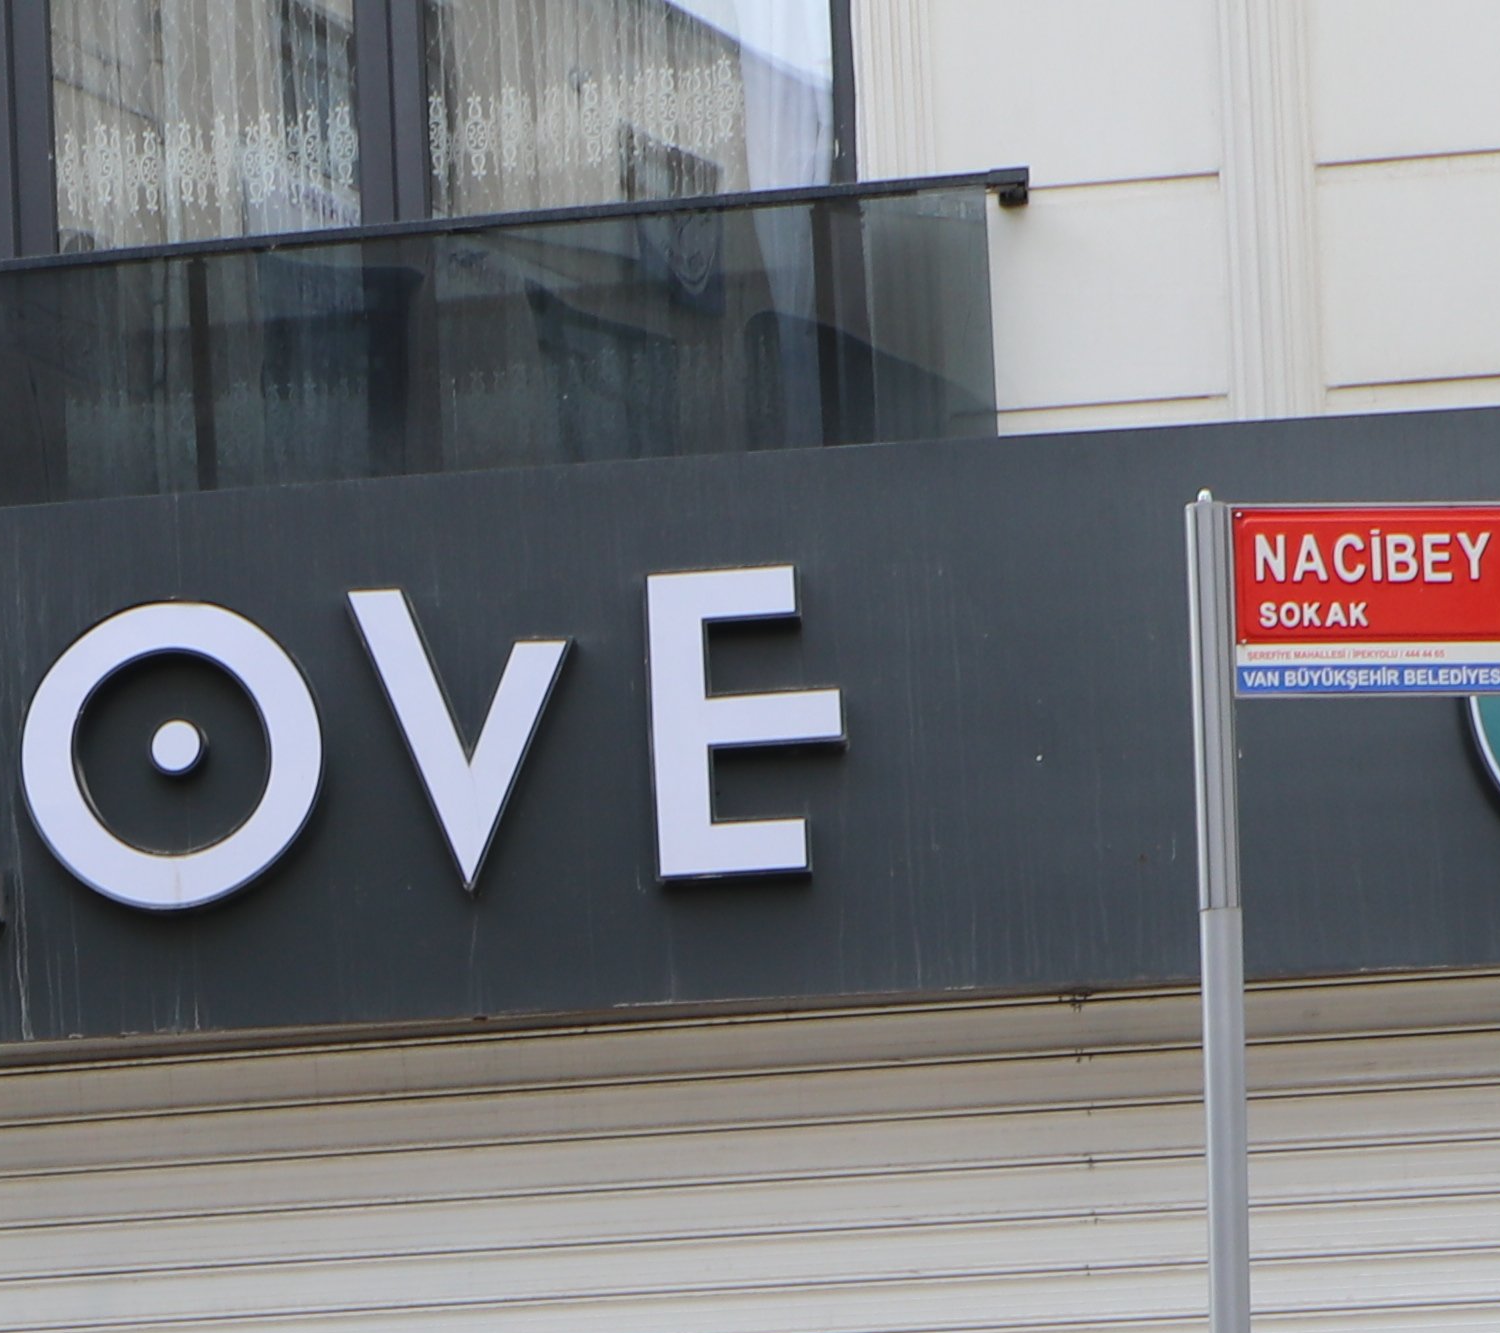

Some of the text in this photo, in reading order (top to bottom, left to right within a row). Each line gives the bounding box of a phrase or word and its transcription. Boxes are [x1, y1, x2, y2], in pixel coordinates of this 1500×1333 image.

[1254, 530, 1491, 583] NACİBEY
[1259, 602, 1369, 628] SOKAK
[1243, 671, 1280, 687] VAN
[1284, 667, 1400, 689] BÜYÜKŞEHİR
